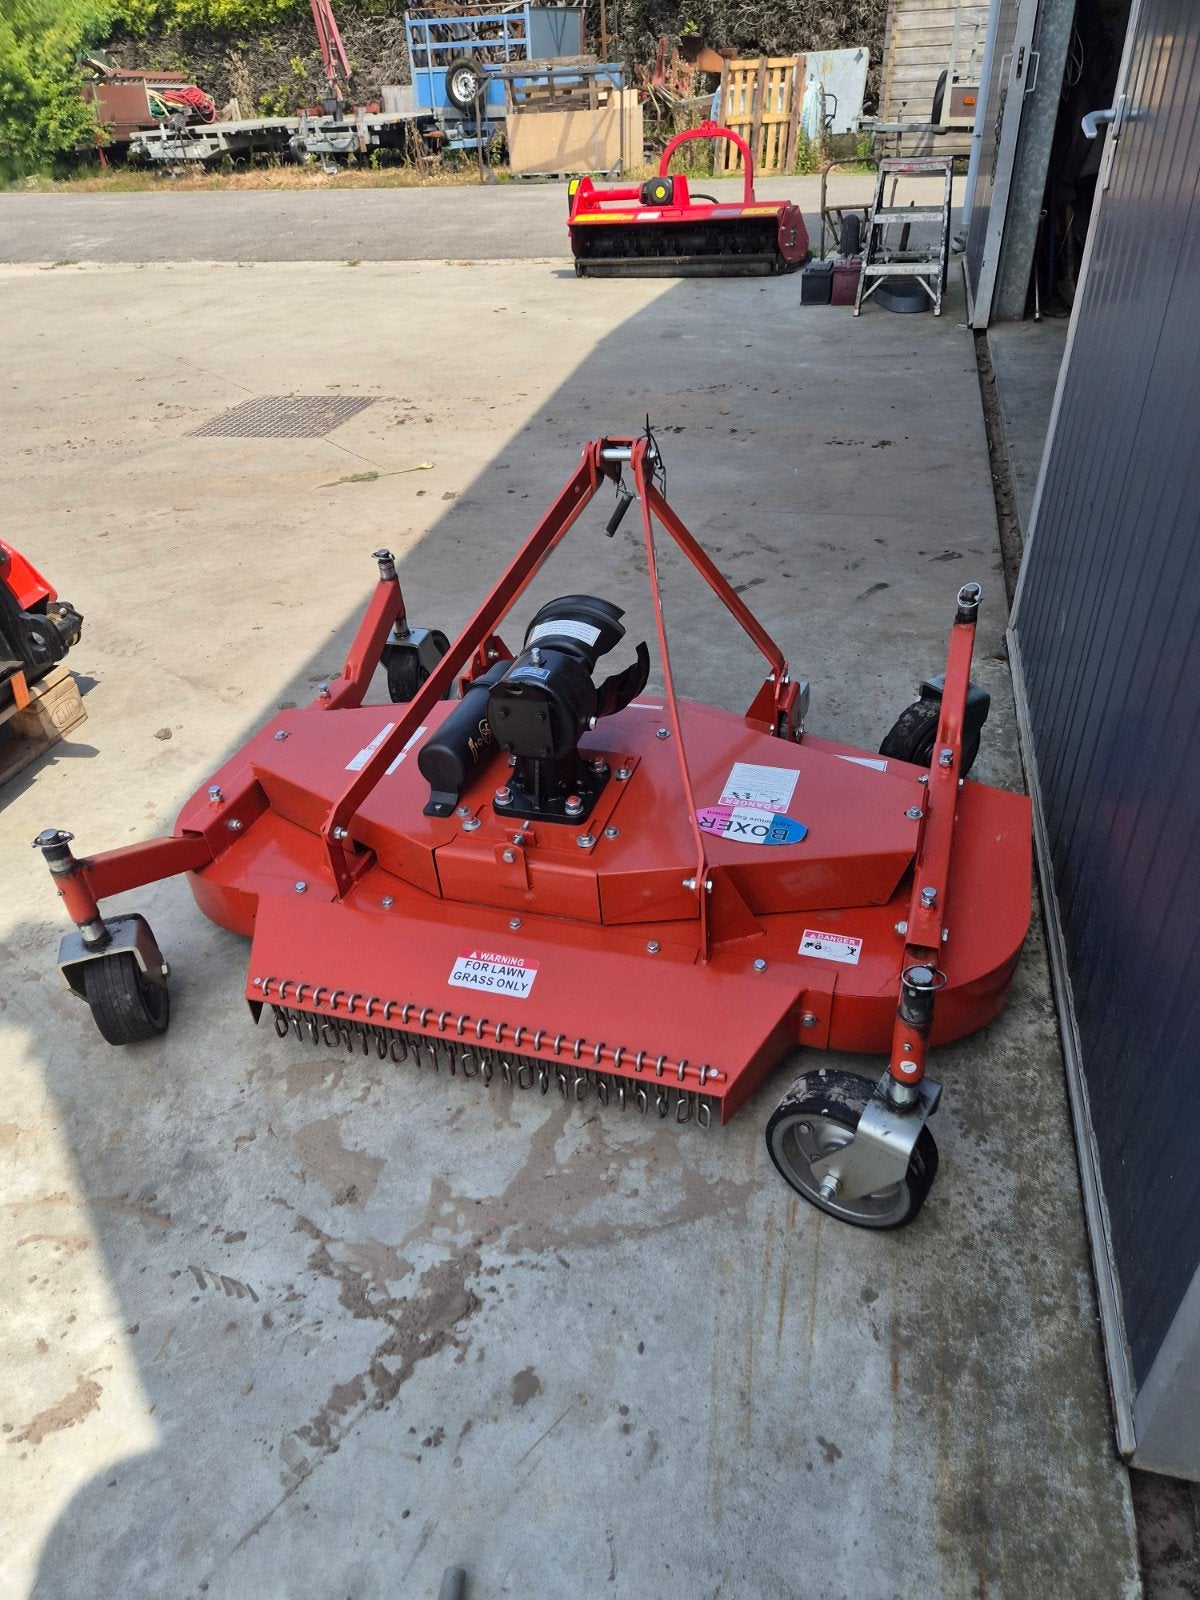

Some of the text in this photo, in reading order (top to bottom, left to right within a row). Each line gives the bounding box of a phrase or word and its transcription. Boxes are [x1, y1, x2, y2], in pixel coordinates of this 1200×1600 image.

[724, 797, 772, 810] DANGER
[699, 816, 789, 840] BOXER
[818, 934, 856, 945] DANGER
[481, 952, 524, 967] WARNING
[465, 961, 525, 978] FOR LAWN
[453, 972, 528, 991] GRASS ONLY
